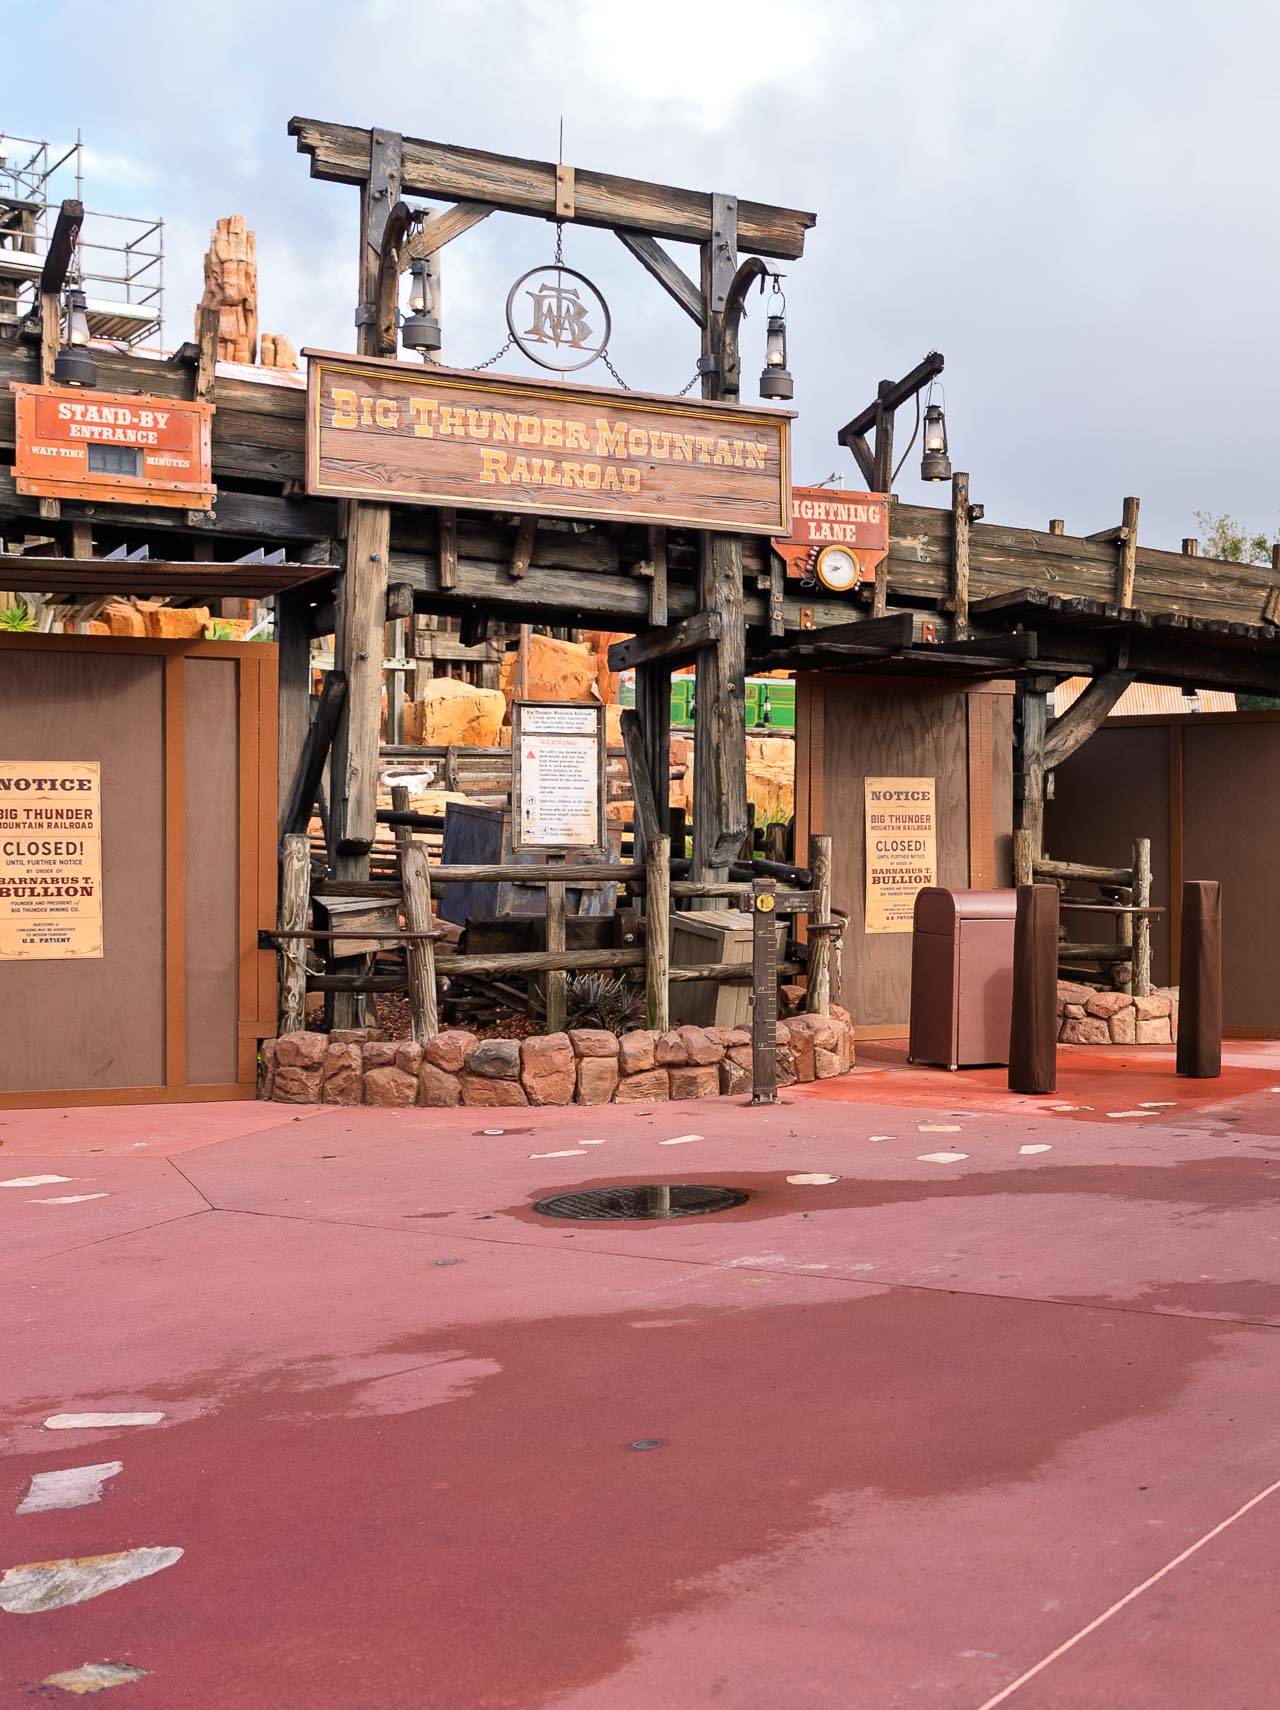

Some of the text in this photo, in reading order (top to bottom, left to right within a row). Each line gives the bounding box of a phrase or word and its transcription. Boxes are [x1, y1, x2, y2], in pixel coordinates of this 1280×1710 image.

[58, 403, 170, 429] STAND-BY
[70, 424, 158, 445] ENTRANCE
[330, 387, 768, 470] BIG THUNDER MOUNTAIN
[32, 445, 85, 459] WAIT TIME
[146, 456, 190, 469] MINUTES
[480, 448, 642, 493] RAILROAD
[792, 500, 880, 524] IGHTNING
[808, 522, 856, 542] LANE
[0, 779, 92, 791] NOTICE
[871, 791, 930, 801] NOTICE
[23, 809, 93, 820] THUNDER
[871, 815, 931, 823] BIG THUNDER
[3, 842, 83, 856] CLOSED!
[876, 840, 926, 852] CLOSED!
[872, 875, 932, 884] BULLION
[0, 886, 94, 897] BULLION
